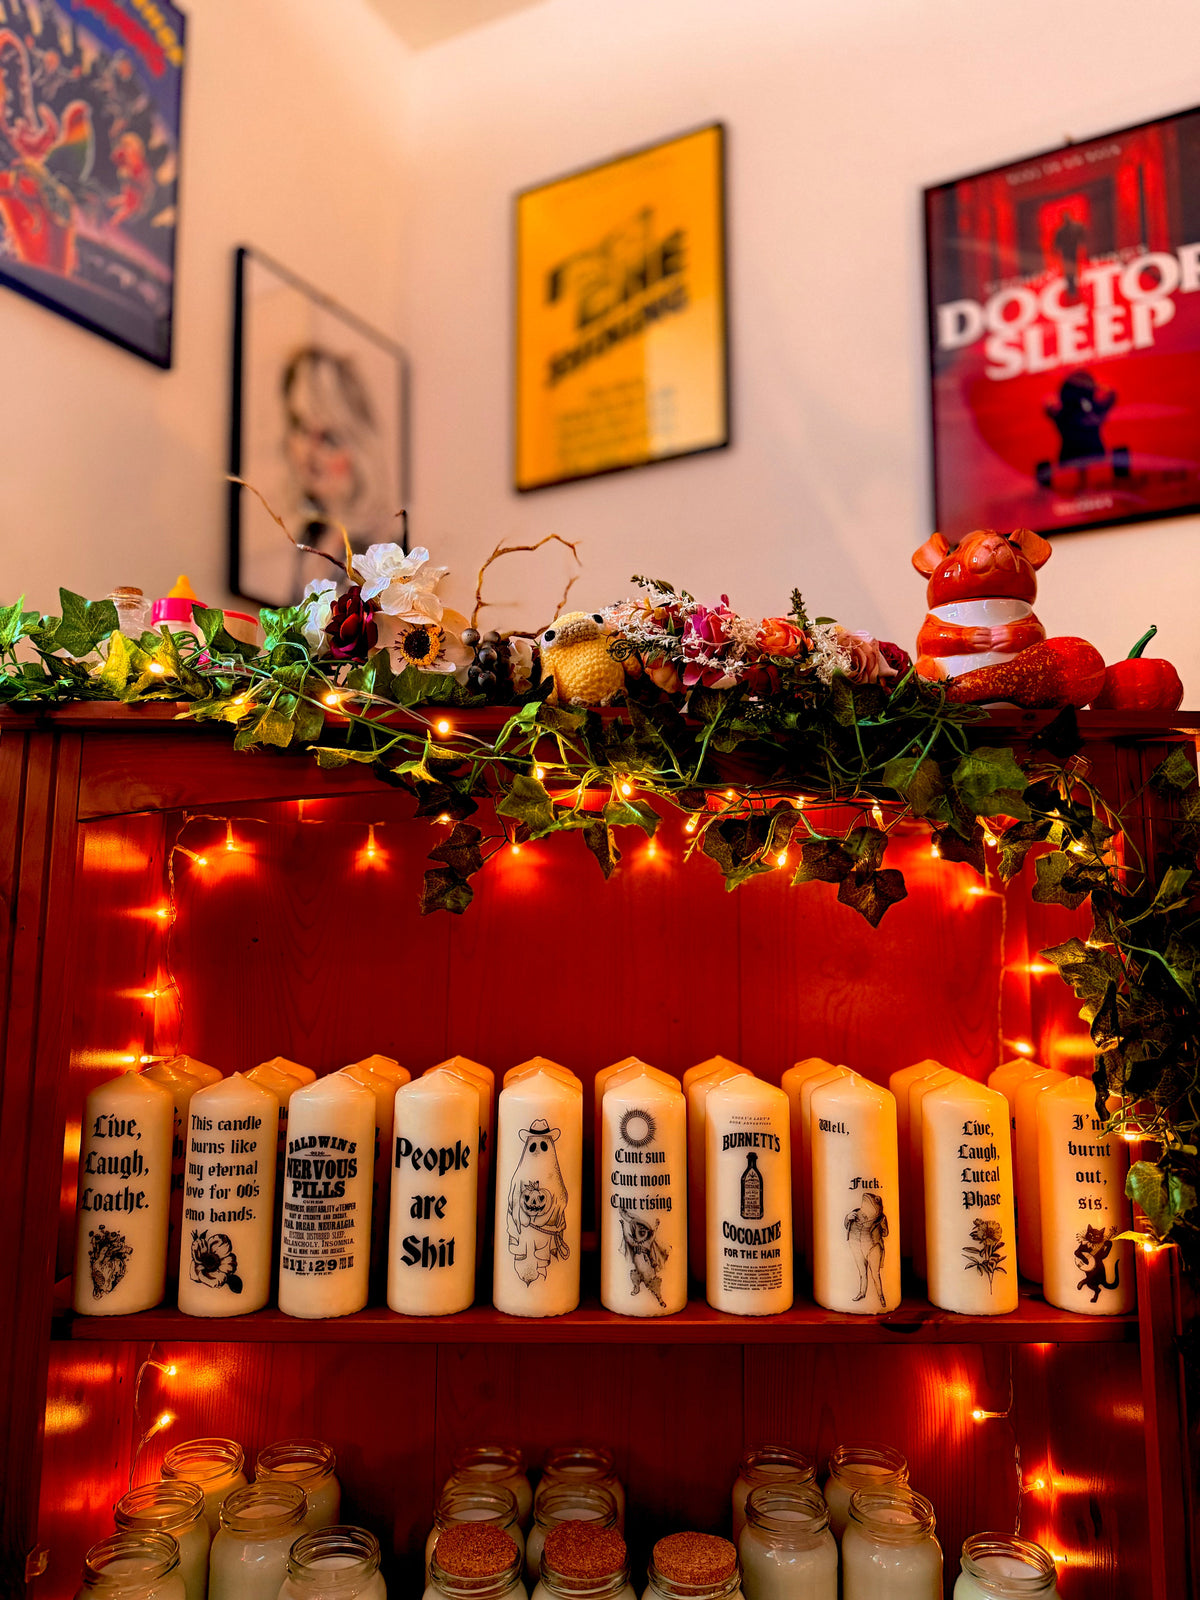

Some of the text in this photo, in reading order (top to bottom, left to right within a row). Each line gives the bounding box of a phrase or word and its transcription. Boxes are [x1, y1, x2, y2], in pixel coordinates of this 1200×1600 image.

[985, 295, 1176, 380] SLEEP
[92, 1113, 142, 1140] Live,
[192, 1114, 213, 1131] This
[217, 1115, 262, 1131] candle
[819, 1118, 850, 1136] Well,
[962, 1120, 994, 1137] Live,
[191, 1138, 225, 1154] burns
[230, 1139, 257, 1154] like
[289, 1135, 357, 1155] BALDWIN'S
[722, 1132, 780, 1152] BURNETT'S
[1068, 1141, 1111, 1157] burnt
[395, 1136, 470, 1176] People
[615, 1148, 666, 1164] Cunt sun
[958, 1143, 1000, 1162] Laugh,
[85, 1149, 149, 1179] Laugh,
[189, 1160, 258, 1181] my eternal
[287, 1157, 358, 1180] NERVOUS
[611, 1171, 671, 1187] Cunt moon
[849, 1177, 883, 1190] Fuck.
[961, 1166, 1000, 1183] Luteal
[1076, 1170, 1107, 1185] out,
[186, 1181, 204, 1198] love
[209, 1183, 231, 1199] for
[292, 1180, 345, 1198] PILLS
[81, 1186, 149, 1215] Loathe.
[410, 1195, 448, 1220] are
[611, 1193, 672, 1212] Cunt rising
[963, 1191, 1001, 1210] Phase
[1078, 1195, 1108, 1210] sis.
[185, 1206, 256, 1223] emo bands.
[723, 1220, 781, 1245] COCOAINE
[401, 1234, 455, 1271] Shit
[724, 1248, 781, 1259] FOR THE HAIR
